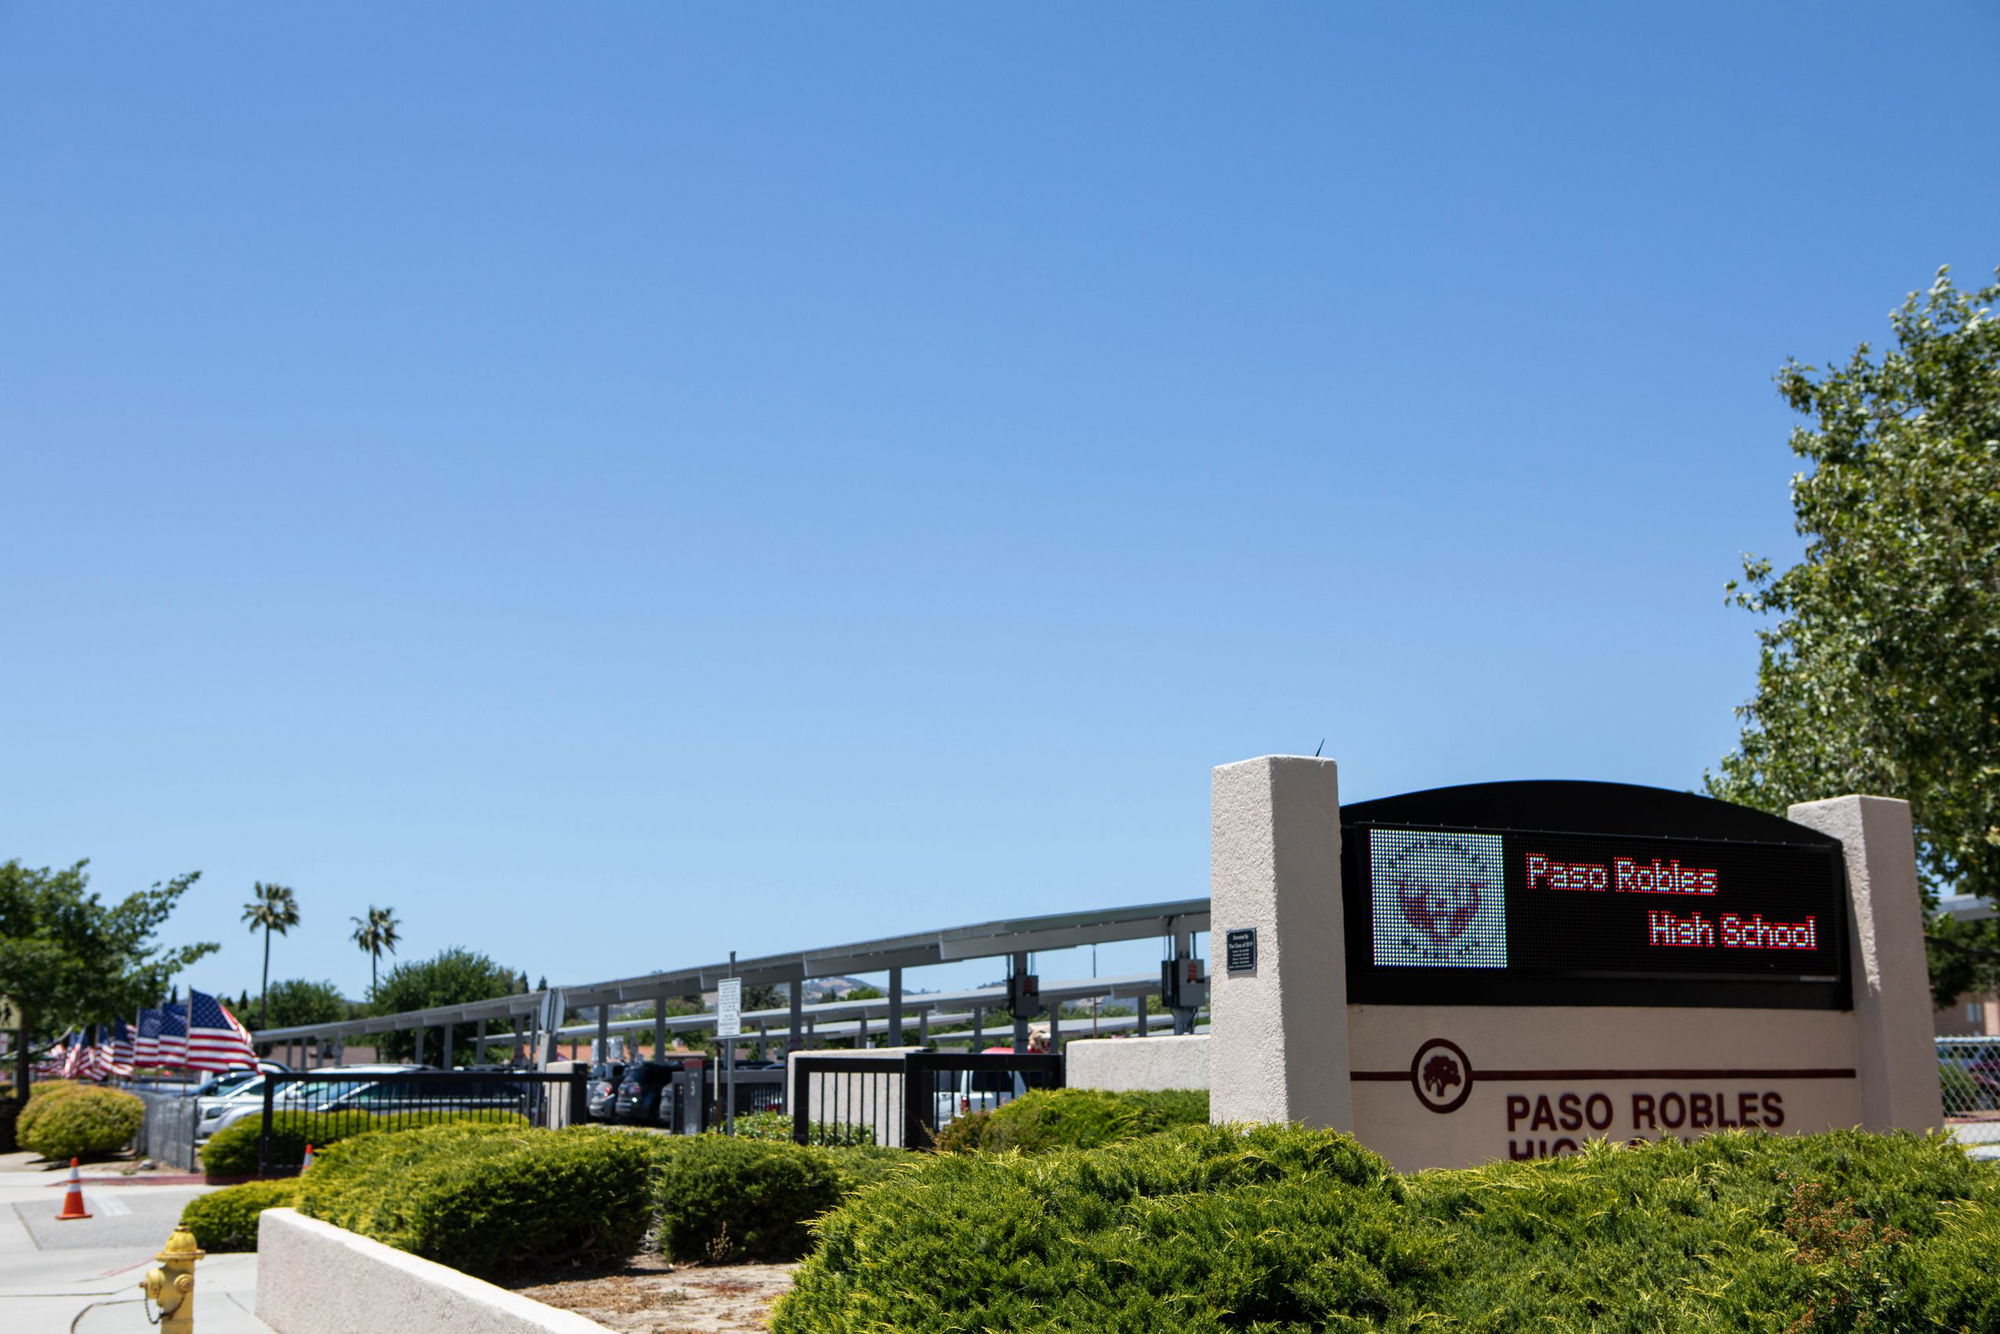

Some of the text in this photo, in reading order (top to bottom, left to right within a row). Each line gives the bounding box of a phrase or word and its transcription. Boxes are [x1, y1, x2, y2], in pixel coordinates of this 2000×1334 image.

[1526, 853, 1719, 896] Paso Robles
[1648, 910, 1817, 950] High School
[1506, 1091, 1785, 1132] PASO ROBLES
[1508, 1138, 1607, 1161] HI
